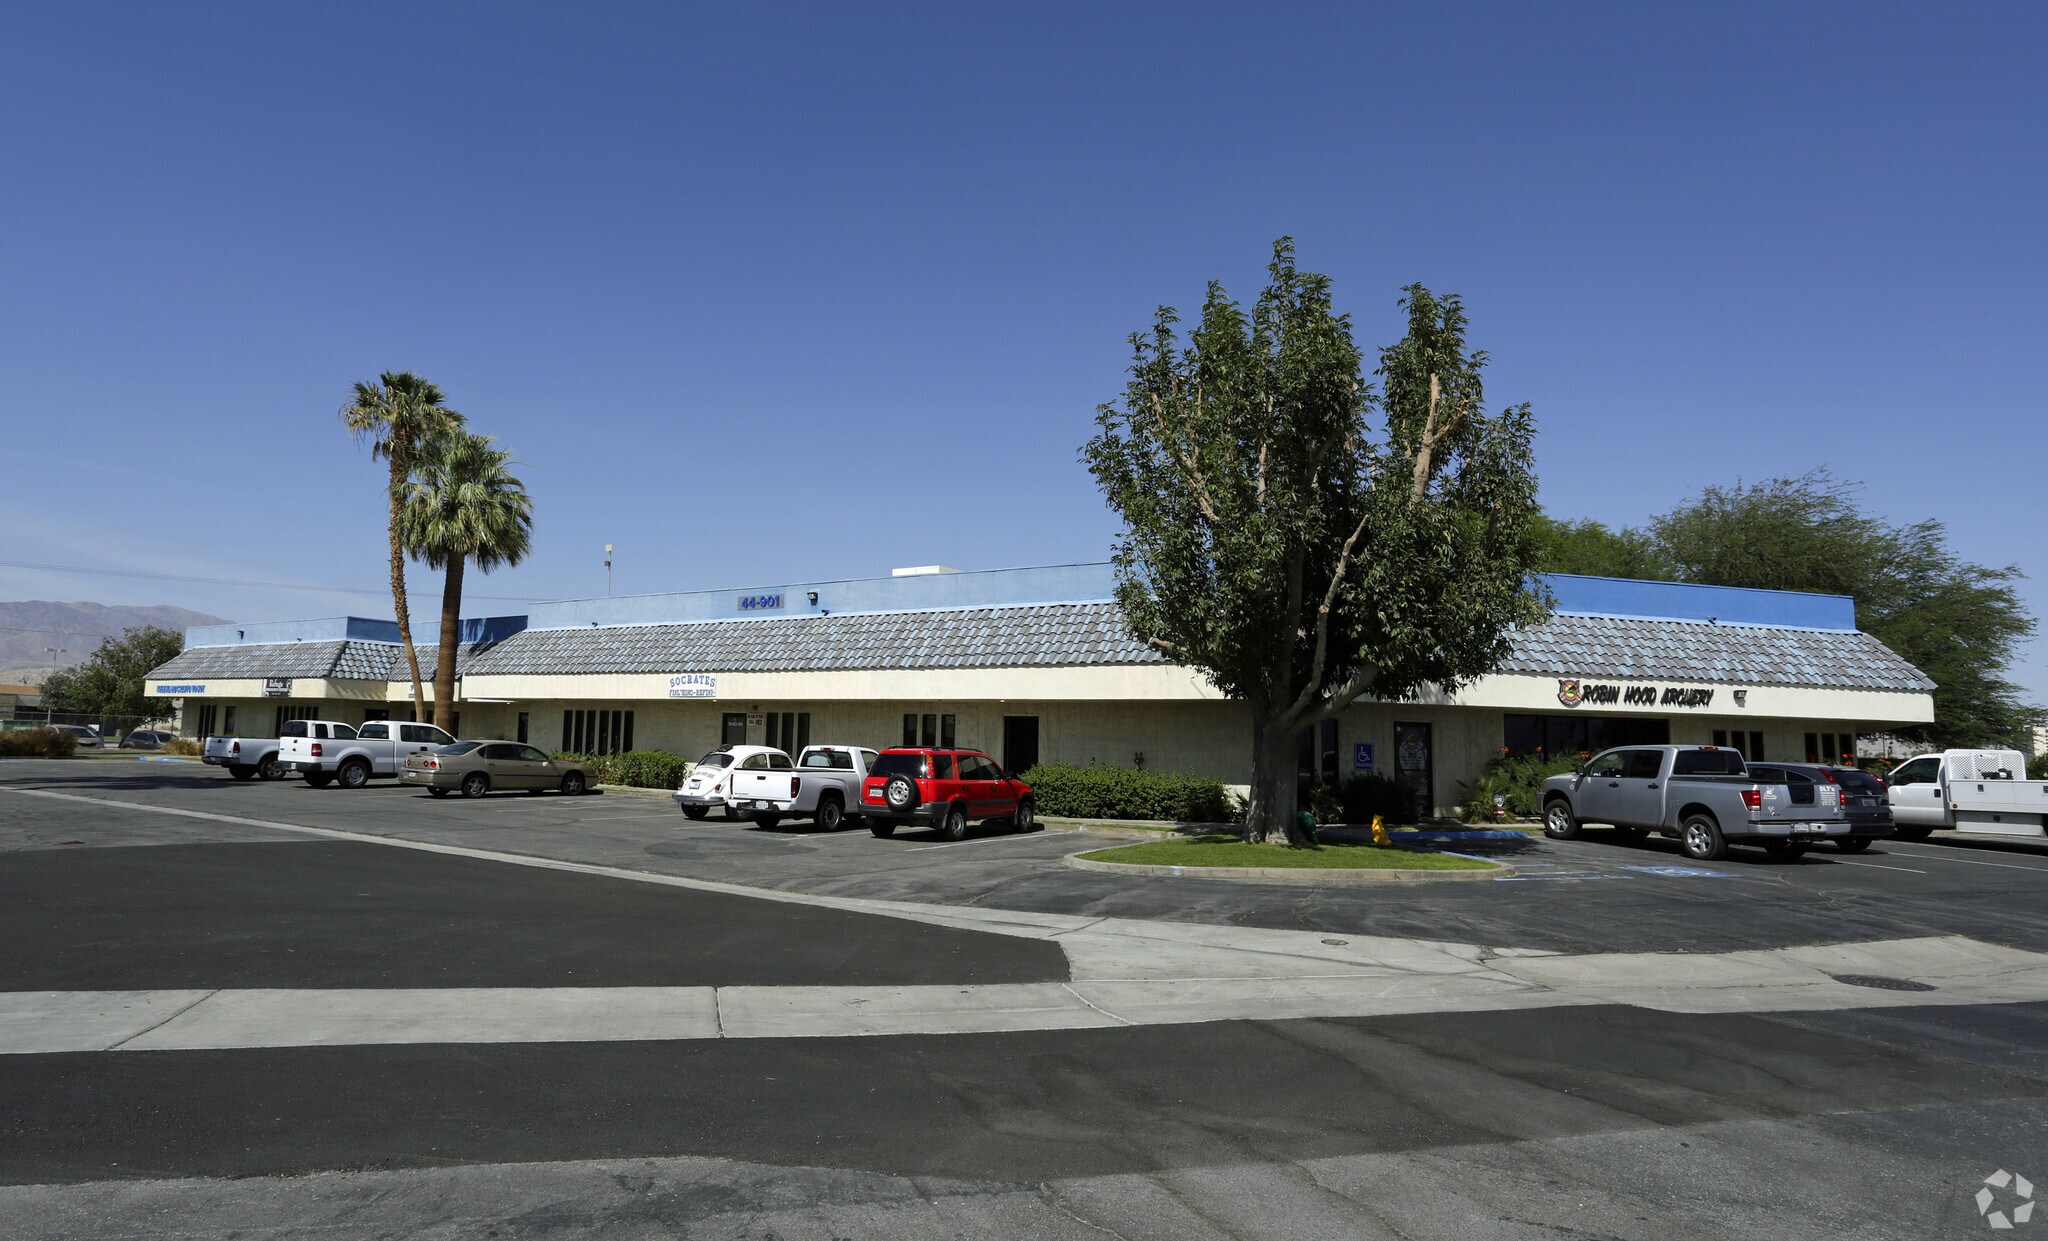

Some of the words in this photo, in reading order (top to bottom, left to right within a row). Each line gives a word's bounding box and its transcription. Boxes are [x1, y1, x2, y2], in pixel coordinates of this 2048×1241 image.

[742, 595, 780, 608] 44-901
[669, 675, 716, 688] SOCRATES
[1581, 684, 1621, 705] ROBIN
[1624, 686, 1657, 706] HOOD
[1660, 687, 1714, 708] ARCHERY
